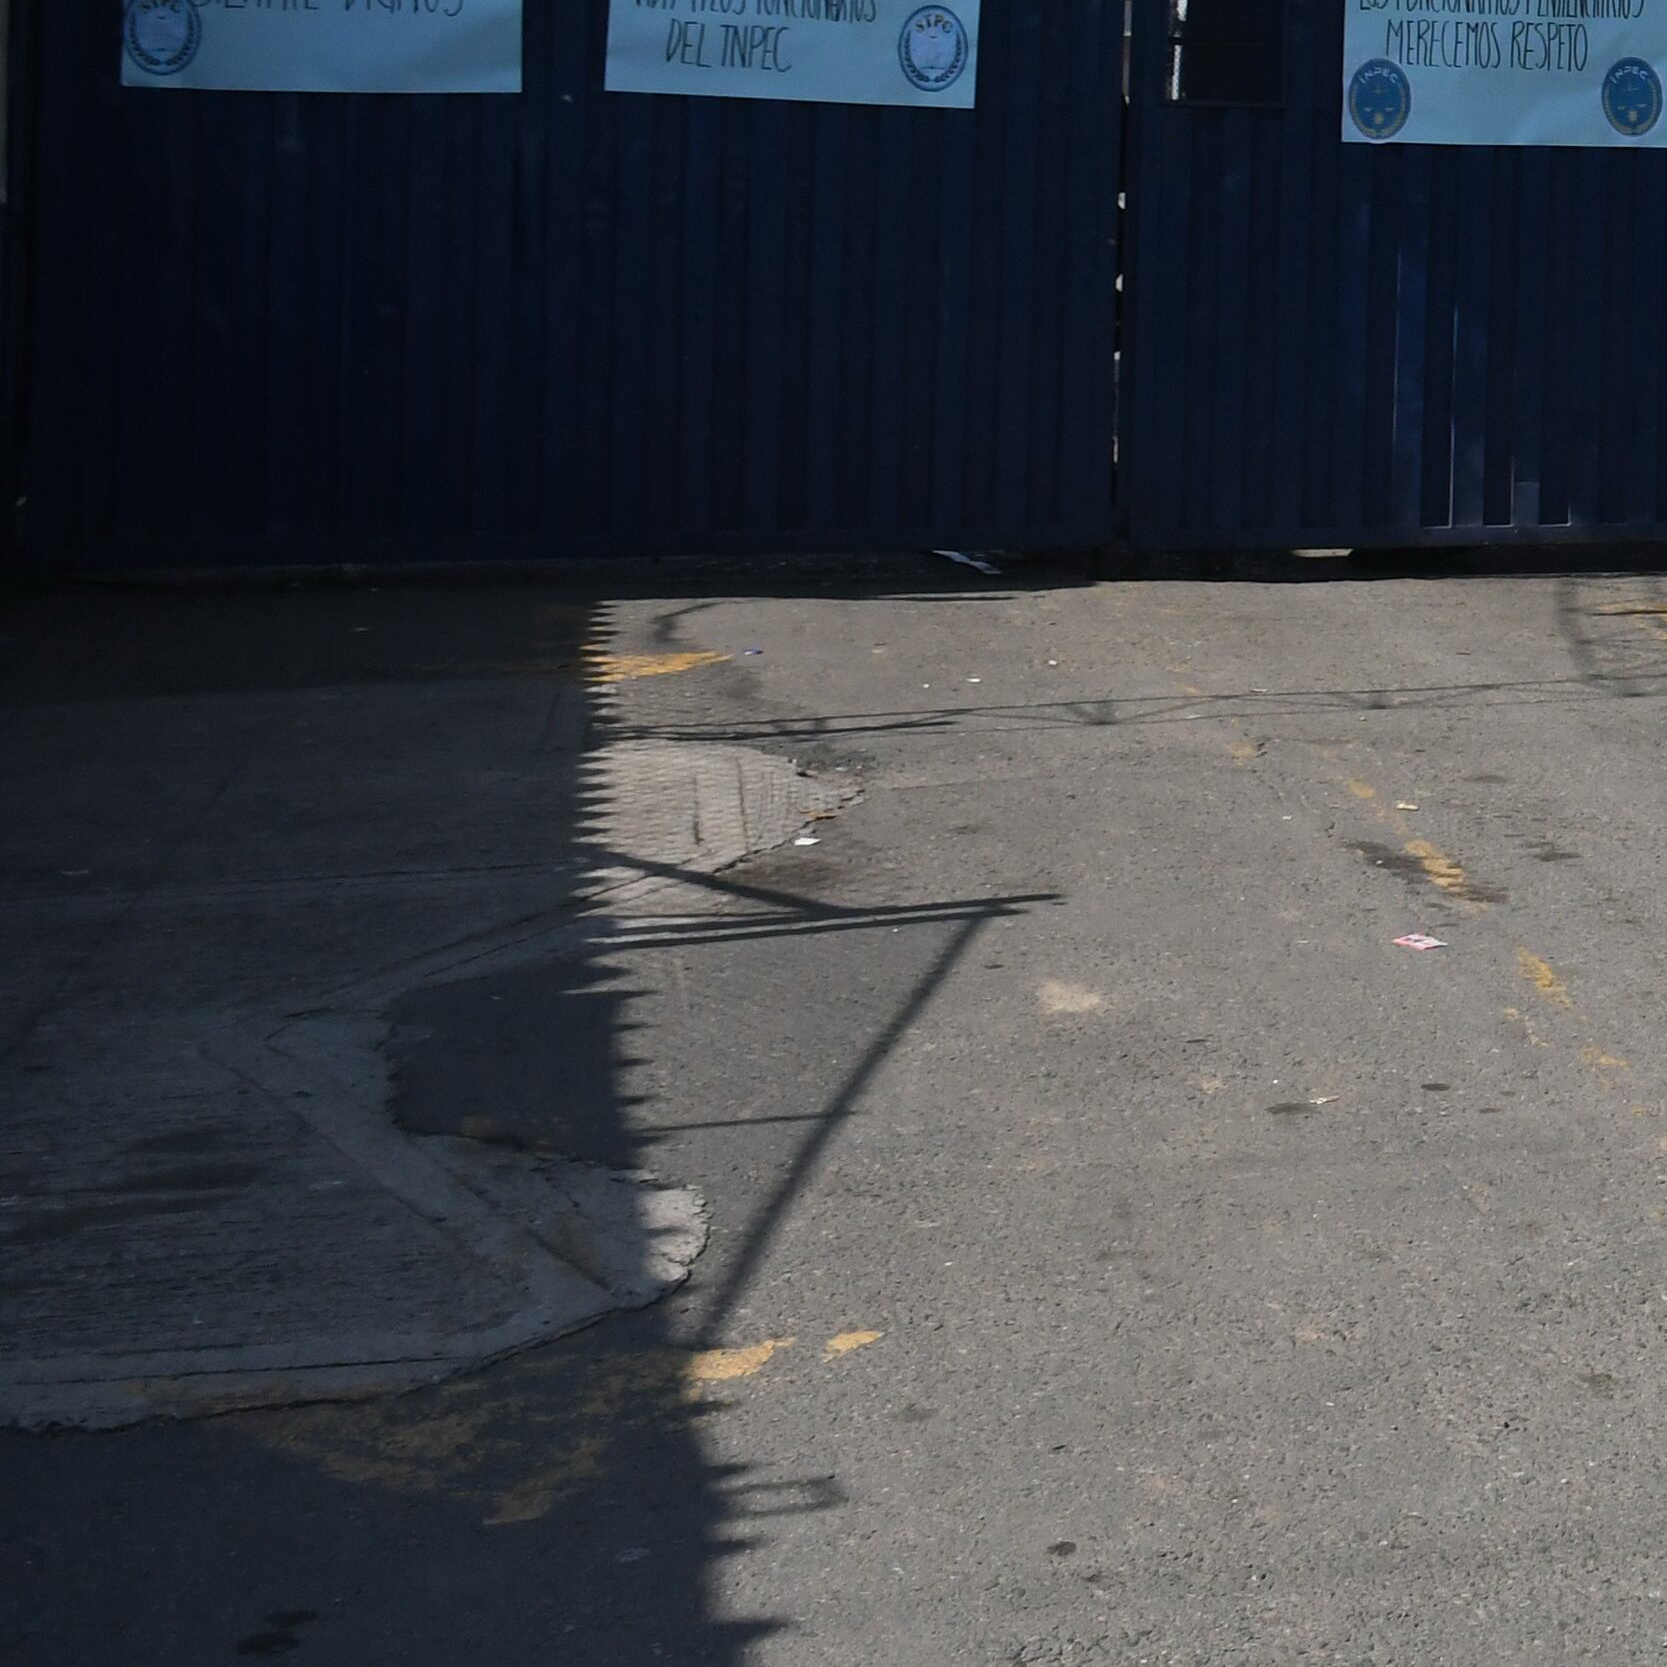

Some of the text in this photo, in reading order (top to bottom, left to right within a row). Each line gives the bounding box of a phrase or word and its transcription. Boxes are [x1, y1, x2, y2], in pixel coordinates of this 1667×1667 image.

[665, 18, 794, 74] DEL INPEC
[913, 13, 954, 34] STPC
[1385, 18, 1589, 72] MERECEMOS RESPETO
